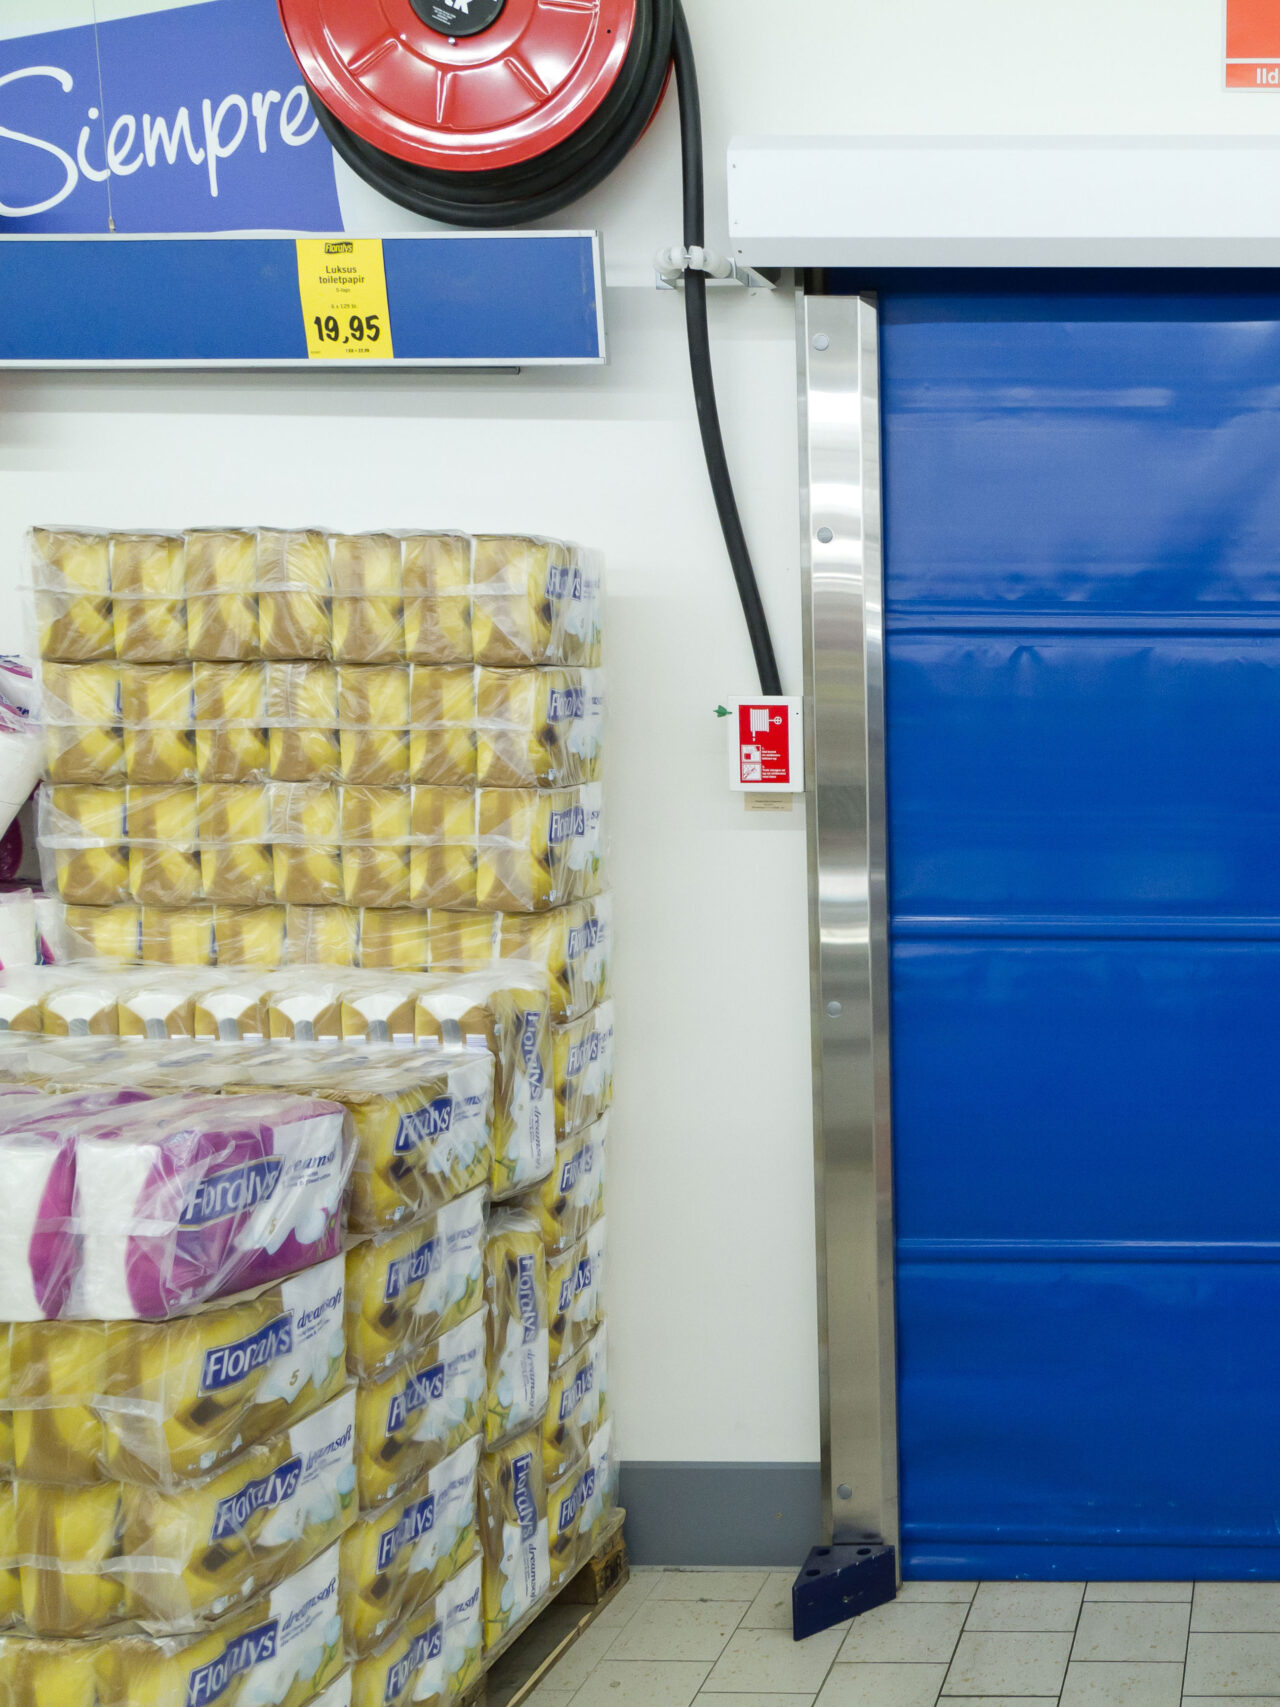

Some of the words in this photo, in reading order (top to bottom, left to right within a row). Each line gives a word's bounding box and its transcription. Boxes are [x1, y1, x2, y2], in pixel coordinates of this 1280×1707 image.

[0, 66, 319, 217] Siempre
[319, 276, 365, 285] toiletpapir
[325, 265, 357, 274] Luksus
[314, 314, 380, 343] 19,95
[205, 1322, 291, 1387] Floralys
[289, 1369, 299, 1386] 5
[190, 1630, 275, 1707] Floralys
